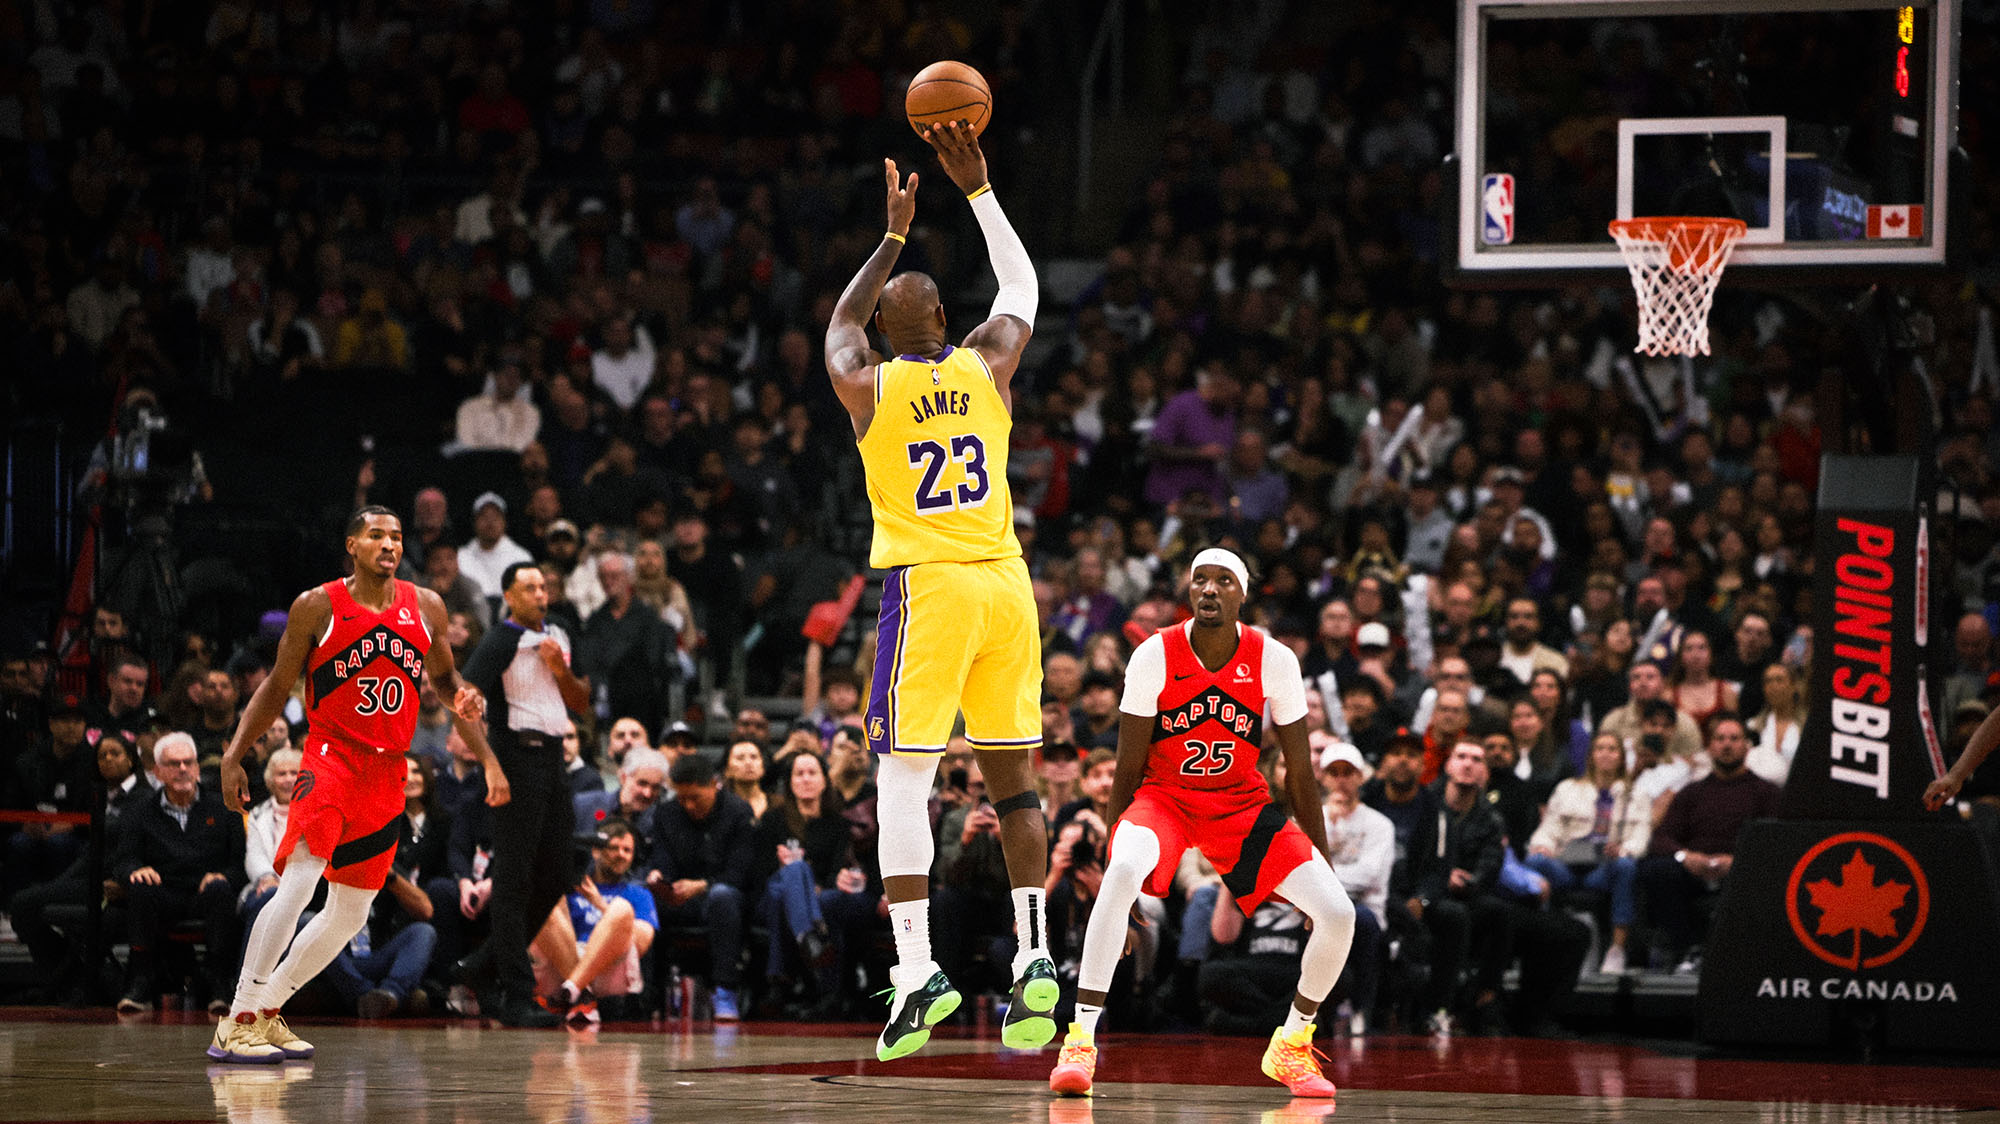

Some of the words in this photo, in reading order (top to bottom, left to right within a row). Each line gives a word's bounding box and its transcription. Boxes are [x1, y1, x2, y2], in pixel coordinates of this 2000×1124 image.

[910, 391, 970, 424] JAMES
[906, 433, 991, 516] 23
[335, 632, 422, 678] RAPTORS
[1830, 518, 1894, 799] POINTSBET
[355, 676, 404, 716] 30
[1180, 739, 1236, 776] 25
[1757, 978, 1812, 998] AIR
[1820, 978, 1958, 1002] CANADA
